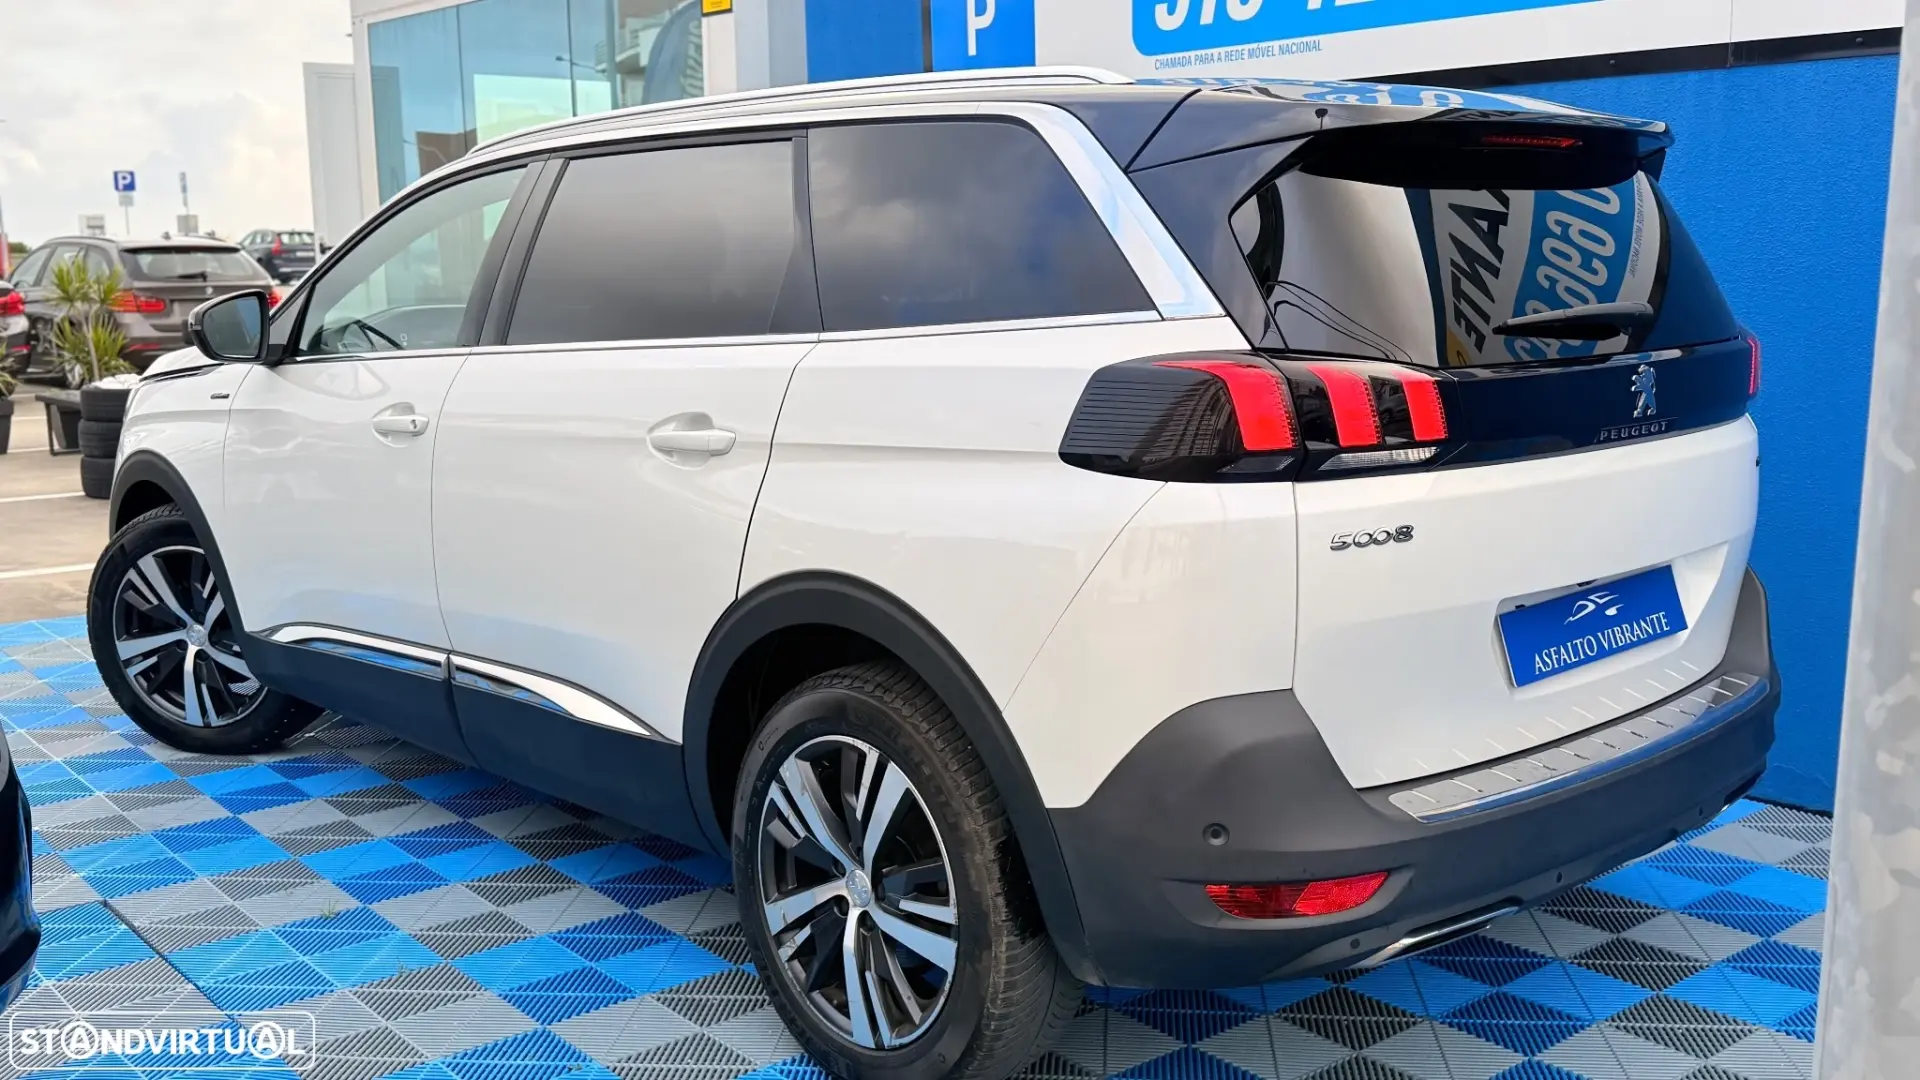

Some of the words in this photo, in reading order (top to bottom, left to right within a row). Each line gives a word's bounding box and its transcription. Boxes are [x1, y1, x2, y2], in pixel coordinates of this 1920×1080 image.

[1154, 55, 1193, 71] CHAMADA
[1194, 52, 1215, 66] PARA
[1216, 51, 1223, 63] A
[1224, 48, 1246, 63] REDE
[1247, 43, 1276, 60] MÓVEL
[1278, 39, 1324, 56] NACIONAL
[118, 172, 132, 191] P
[1600, 421, 1669, 441] PEUGEOT
[1330, 525, 1415, 551] 5008
[1534, 635, 1598, 675] ASFALTO
[1597, 611, 1671, 651] VIBRANTE
